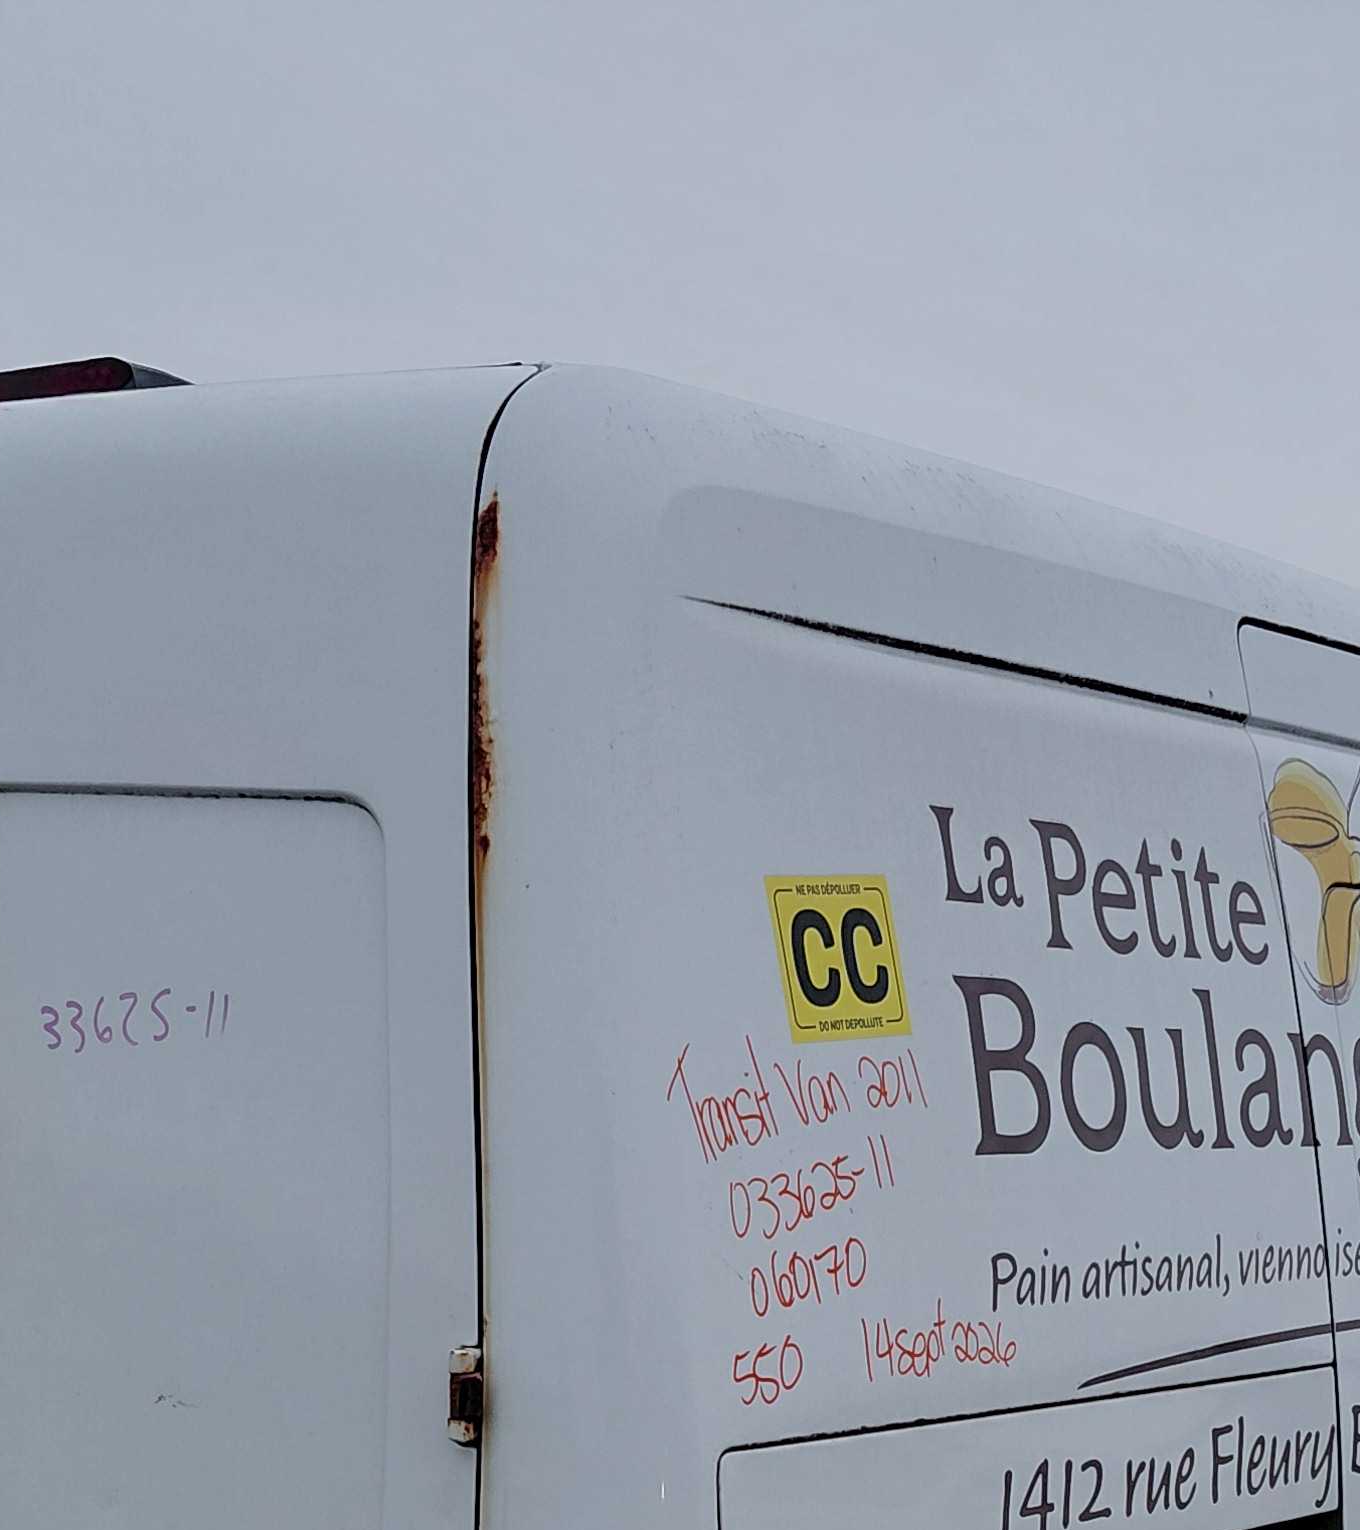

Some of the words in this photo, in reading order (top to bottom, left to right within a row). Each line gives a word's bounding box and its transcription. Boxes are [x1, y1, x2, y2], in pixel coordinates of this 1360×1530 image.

[795, 884, 806, 896] NE
[806, 884, 820, 895] PAS
[820, 881, 861, 895] DÉPOLLUER
[928, 804, 1024, 908] La
[1028, 818, 1270, 966] Petite
[791, 908, 889, 1007] CC
[40, 987, 229, 1053] 33625-11
[819, 1020, 829, 1032] DO
[830, 1019, 844, 1031] NOT
[845, 1016, 884, 1030] DEPOLLUTE
[773, 1059, 850, 1126] Van
[858, 1048, 928, 1109] 2011
[729, 1134, 894, 1239] 033625-11
[991, 1247, 1071, 1312] Pain
[1081, 1234, 1230, 1302] artisanal,
[1125, 1446, 1198, 1518] rue
[1211, 1415, 1338, 1510] Fleury
